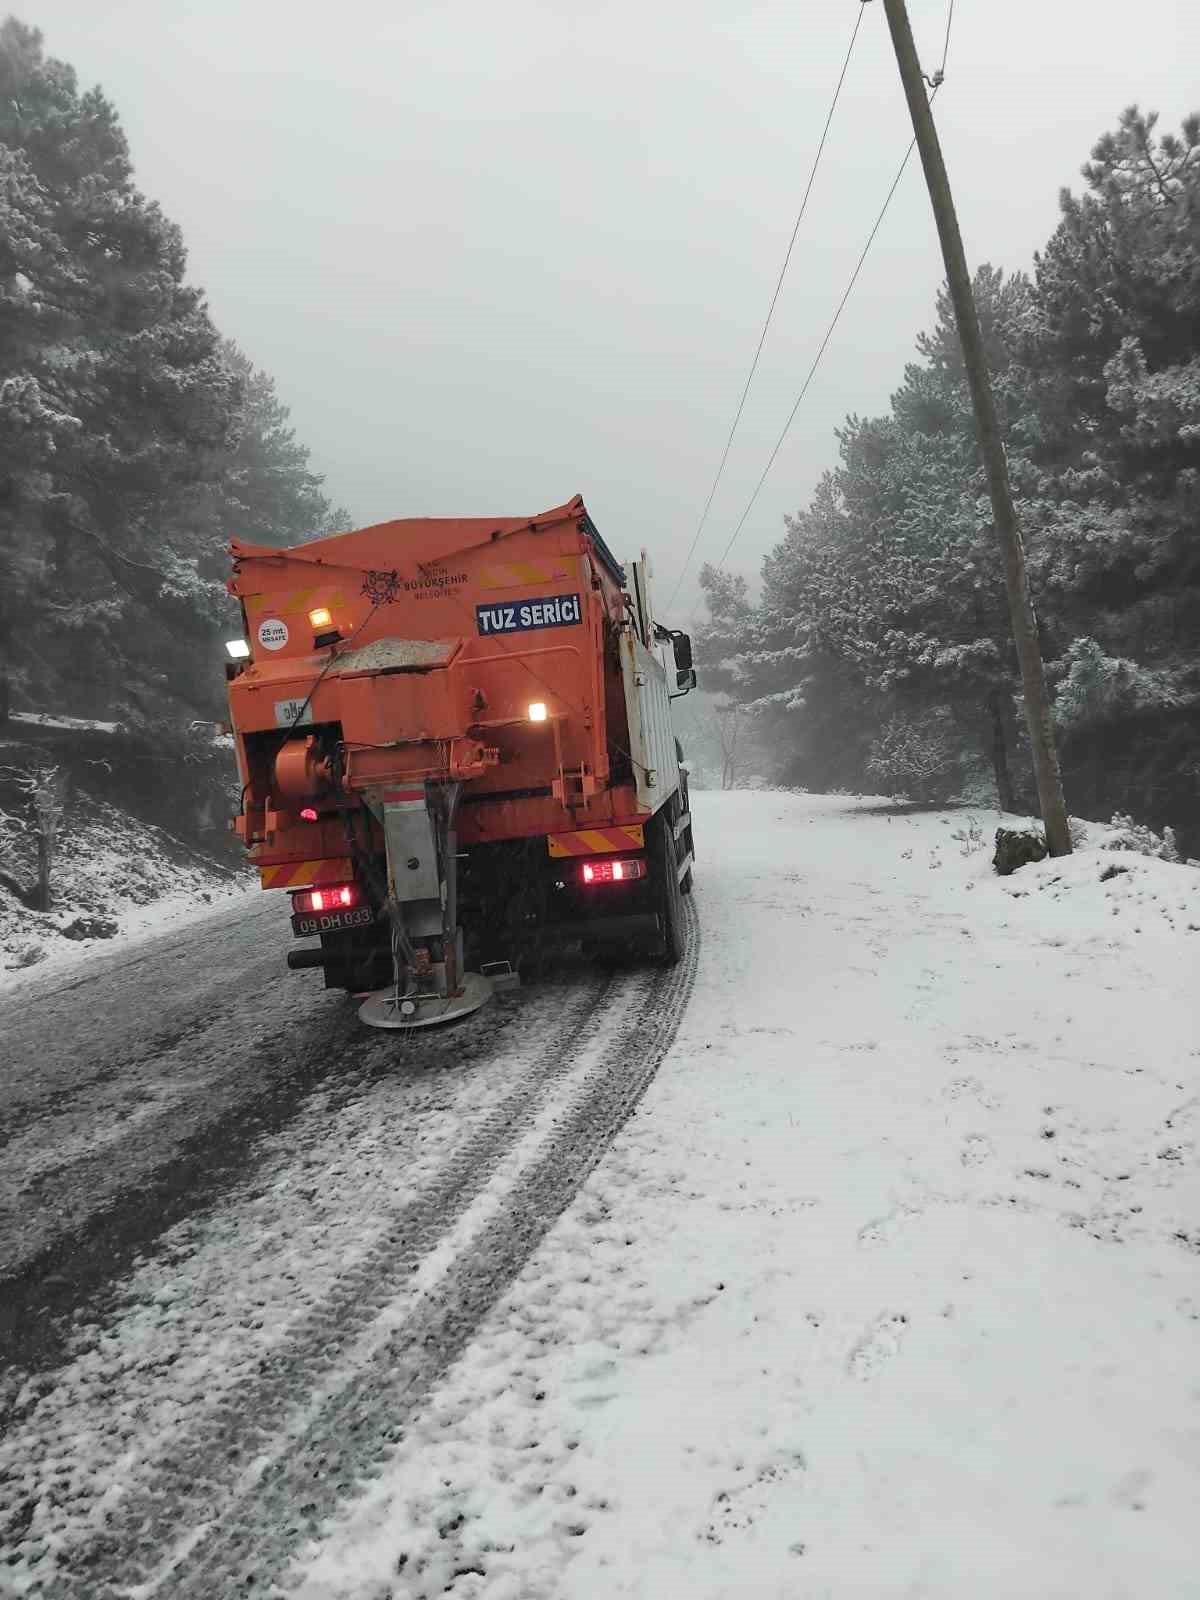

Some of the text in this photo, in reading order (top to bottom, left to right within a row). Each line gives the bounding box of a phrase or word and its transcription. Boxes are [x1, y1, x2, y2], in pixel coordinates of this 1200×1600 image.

[479, 595, 580, 632] TUZ SERİCİ
[261, 628, 271, 636] 25
[300, 909, 370, 933] 09 DH 033
